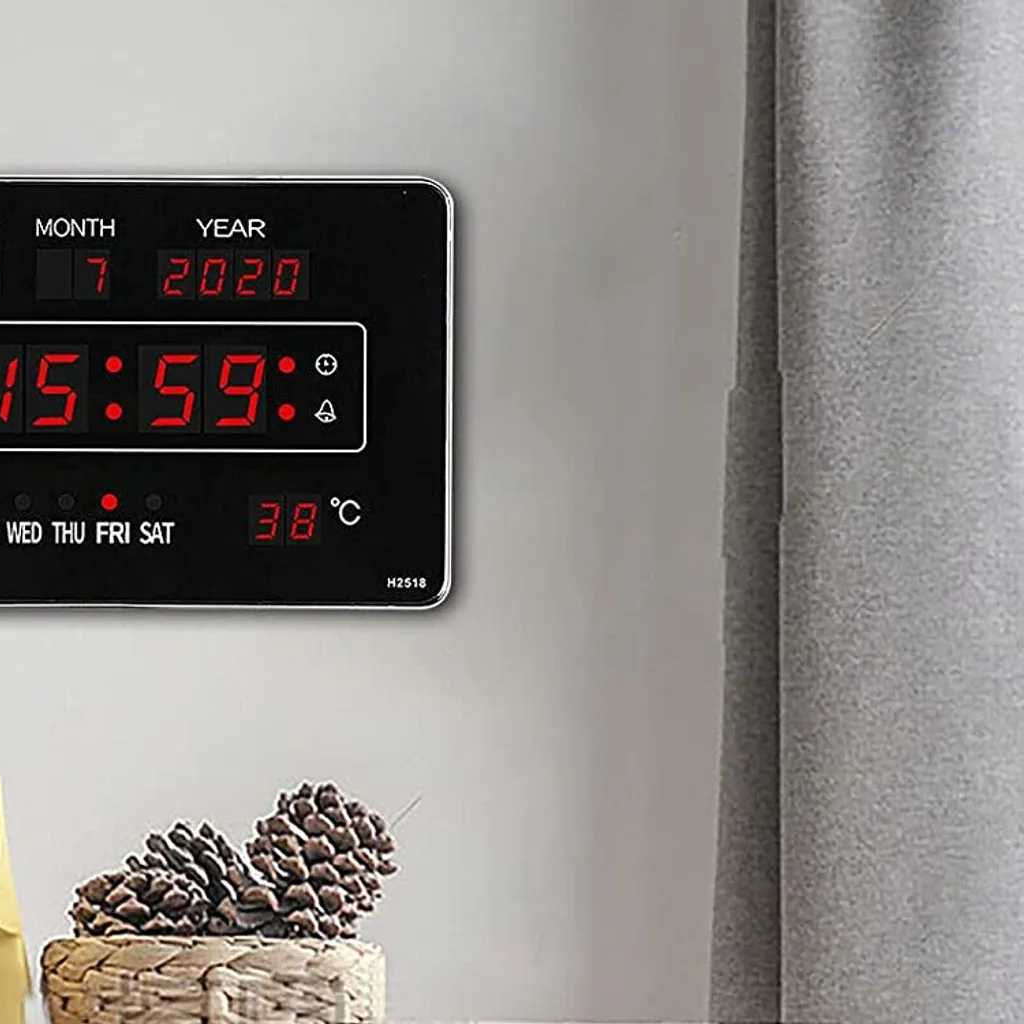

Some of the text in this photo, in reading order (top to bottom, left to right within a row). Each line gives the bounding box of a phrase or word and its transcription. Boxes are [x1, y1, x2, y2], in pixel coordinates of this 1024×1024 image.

[36, 218, 115, 237] MONTH
[196, 219, 265, 238] YEAR
[88, 258, 106, 292] 7
[164, 259, 300, 295] 2020
[6, 522, 42, 543] WED
[52, 522, 85, 544] THU
[96, 522, 130, 544] FRI
[140, 521, 175, 544] SAT
[256, 503, 316, 539] 38
[387, 578, 426, 588] H2518
